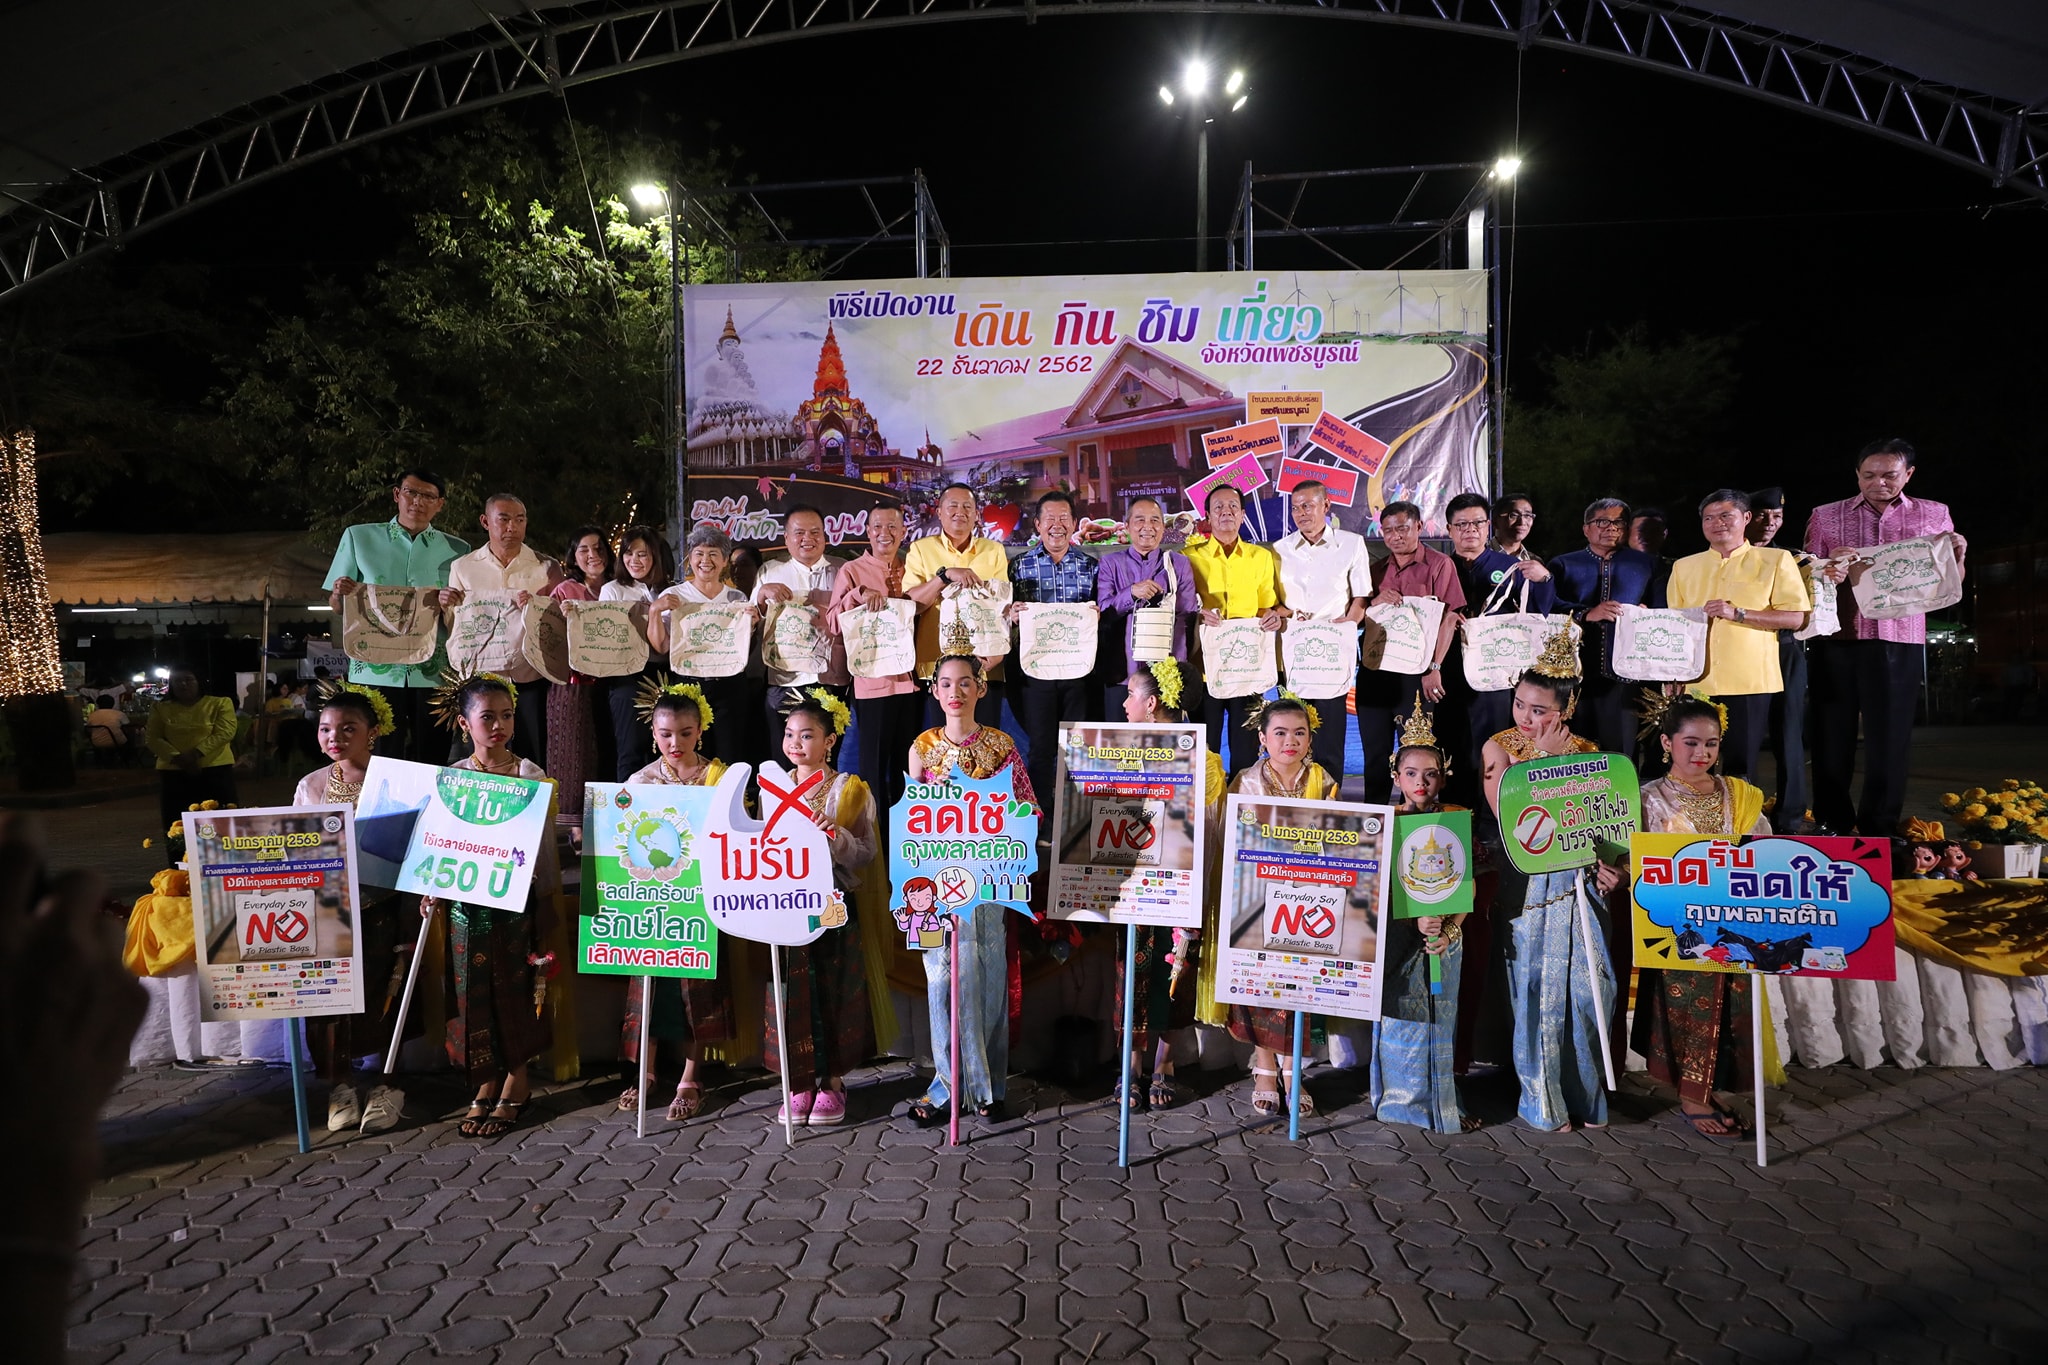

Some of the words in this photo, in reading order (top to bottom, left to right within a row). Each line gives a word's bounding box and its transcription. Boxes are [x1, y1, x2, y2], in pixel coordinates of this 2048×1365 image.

[829, 290, 956, 318] พิธีเปิดงาน
[954, 303, 1033, 347] เดิน
[1053, 303, 1118, 346] กิน
[1137, 299, 1200, 343] ชิม
[1217, 281, 1323, 342] เที่ยว
[916, 359, 944, 375] 22
[952, 354, 1030, 375] ธันวาคม
[1038, 355, 1093, 373] 2562
[1201, 341, 1360, 369] จังหวัดเพชรบูรณ์
[693, 496, 747, 518] ถนน
[1088, 747, 1095, 758] 1
[1099, 748, 1142, 759] มกราคม
[1146, 749, 1174, 760] 2563
[1528, 756, 1608, 782] ชาวเพชรบูรณ์
[443, 775, 529, 797] ถุงพลาสติกเพียง
[1531, 777, 1612, 801] ทำความดีด้วยหัวใจ
[456, 796, 468, 816] 1
[476, 791, 502, 821] ใบ
[906, 791, 1008, 834] ลดใช้
[1099, 806, 1138, 818] Everyday
[1141, 808, 1158, 818] Say
[223, 838, 231, 849] 1
[235, 836, 284, 848] มกราคม
[288, 833, 320, 847] 2563
[423, 831, 509, 859] ใช้เวลาย่อยสลาย
[1097, 818, 1156, 850] NO
[1262, 825, 1270, 837] 1
[1275, 827, 1322, 841] มกราคม
[1327, 831, 1358, 844] 2563
[709, 831, 810, 881] ไม่รับ
[902, 836, 1028, 868] ถุงพลาสติก
[1108, 851, 1134, 859] Plastic
[1136, 852, 1154, 861] Bags
[413, 854, 479, 892] 450
[487, 860, 515, 898] ปี
[1642, 839, 1754, 886] ลดรับ
[1729, 855, 1854, 902] ลดให้
[243, 900, 286, 910] Everyday
[289, 899, 308, 909] Say
[713, 888, 822, 918] ถุงพลาสติก
[1273, 890, 1317, 903] Everyday
[1319, 895, 1338, 906] Say
[246, 909, 309, 945] NO
[591, 902, 707, 941] รักษ์โลก
[1271, 903, 1336, 938] NO
[1685, 903, 1838, 927] ถุงพลาสติก
[245, 947, 256, 955] To
[259, 946, 287, 954] Plastic
[289, 945, 309, 953] Bags
[588, 943, 711, 968] เลิกพลาสติก
[1270, 936, 1280, 944] To
[1282, 937, 1311, 947] Plastic
[1313, 941, 1334, 950] Bags
